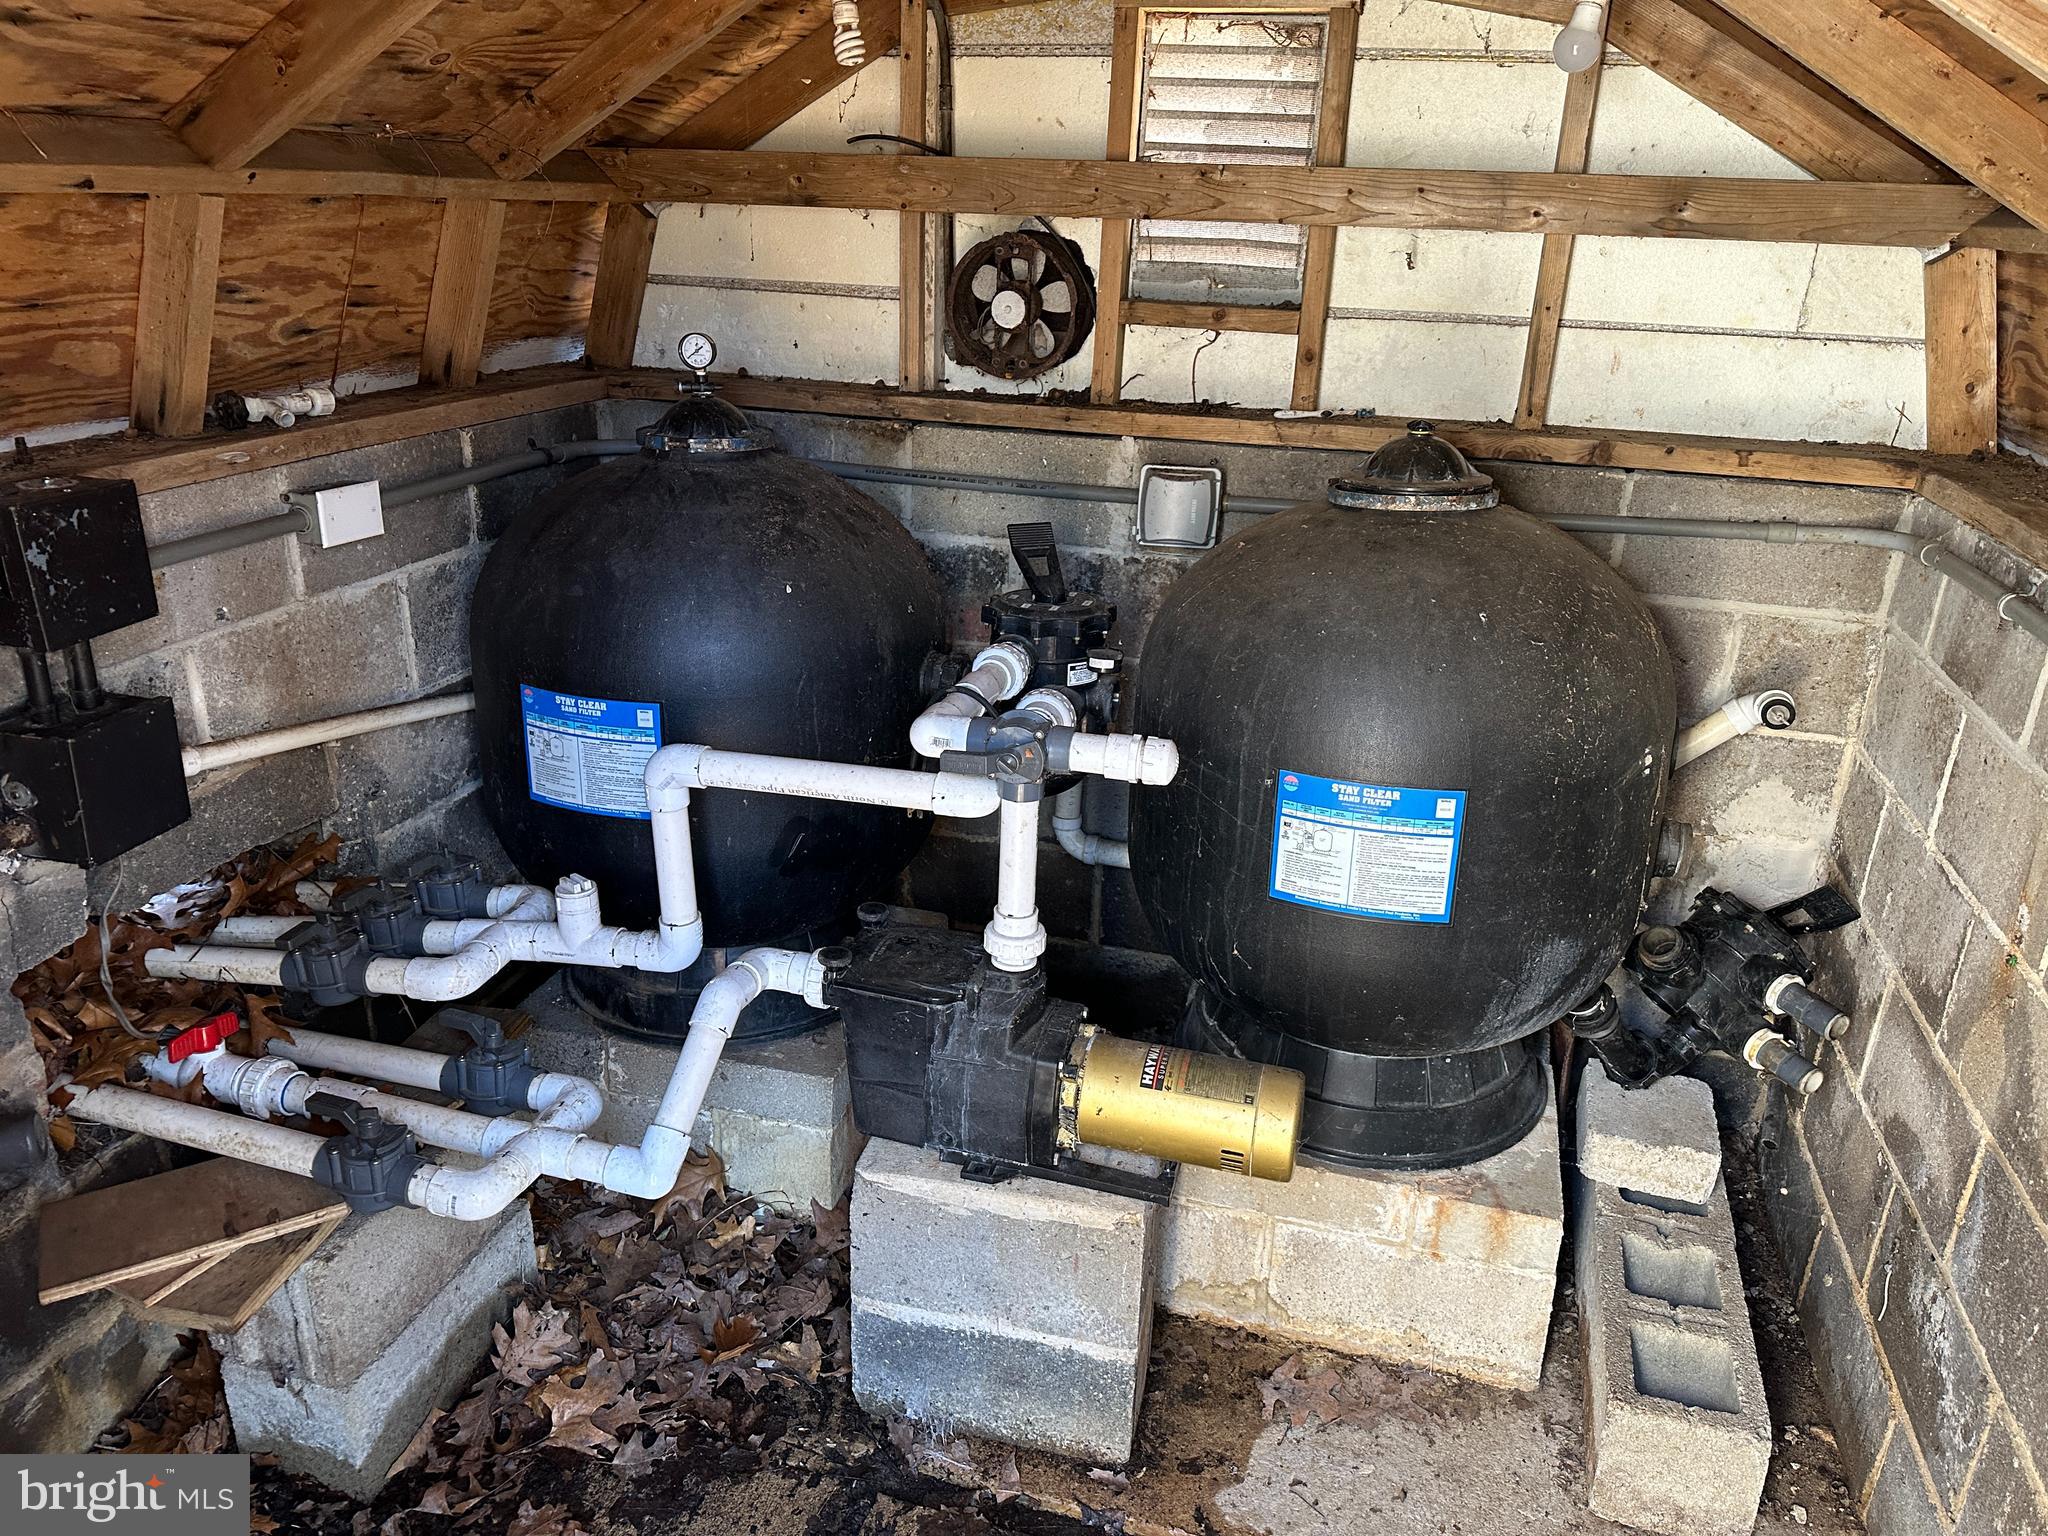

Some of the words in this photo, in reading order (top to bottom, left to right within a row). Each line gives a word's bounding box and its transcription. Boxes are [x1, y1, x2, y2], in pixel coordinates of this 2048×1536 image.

[555, 695, 575, 706] STAY
[578, 699, 607, 711] CLEAR
[561, 705, 577, 713] SAND
[579, 708, 602, 717] FILTER
[788, 788, 840, 799] American
[1331, 783, 1360, 796] STAY
[1363, 788, 1401, 801] CLEAR
[1338, 793, 1360, 803] SAND
[1362, 797, 1393, 807] FILTER
[1158, 1056, 1169, 1080] SUPER
